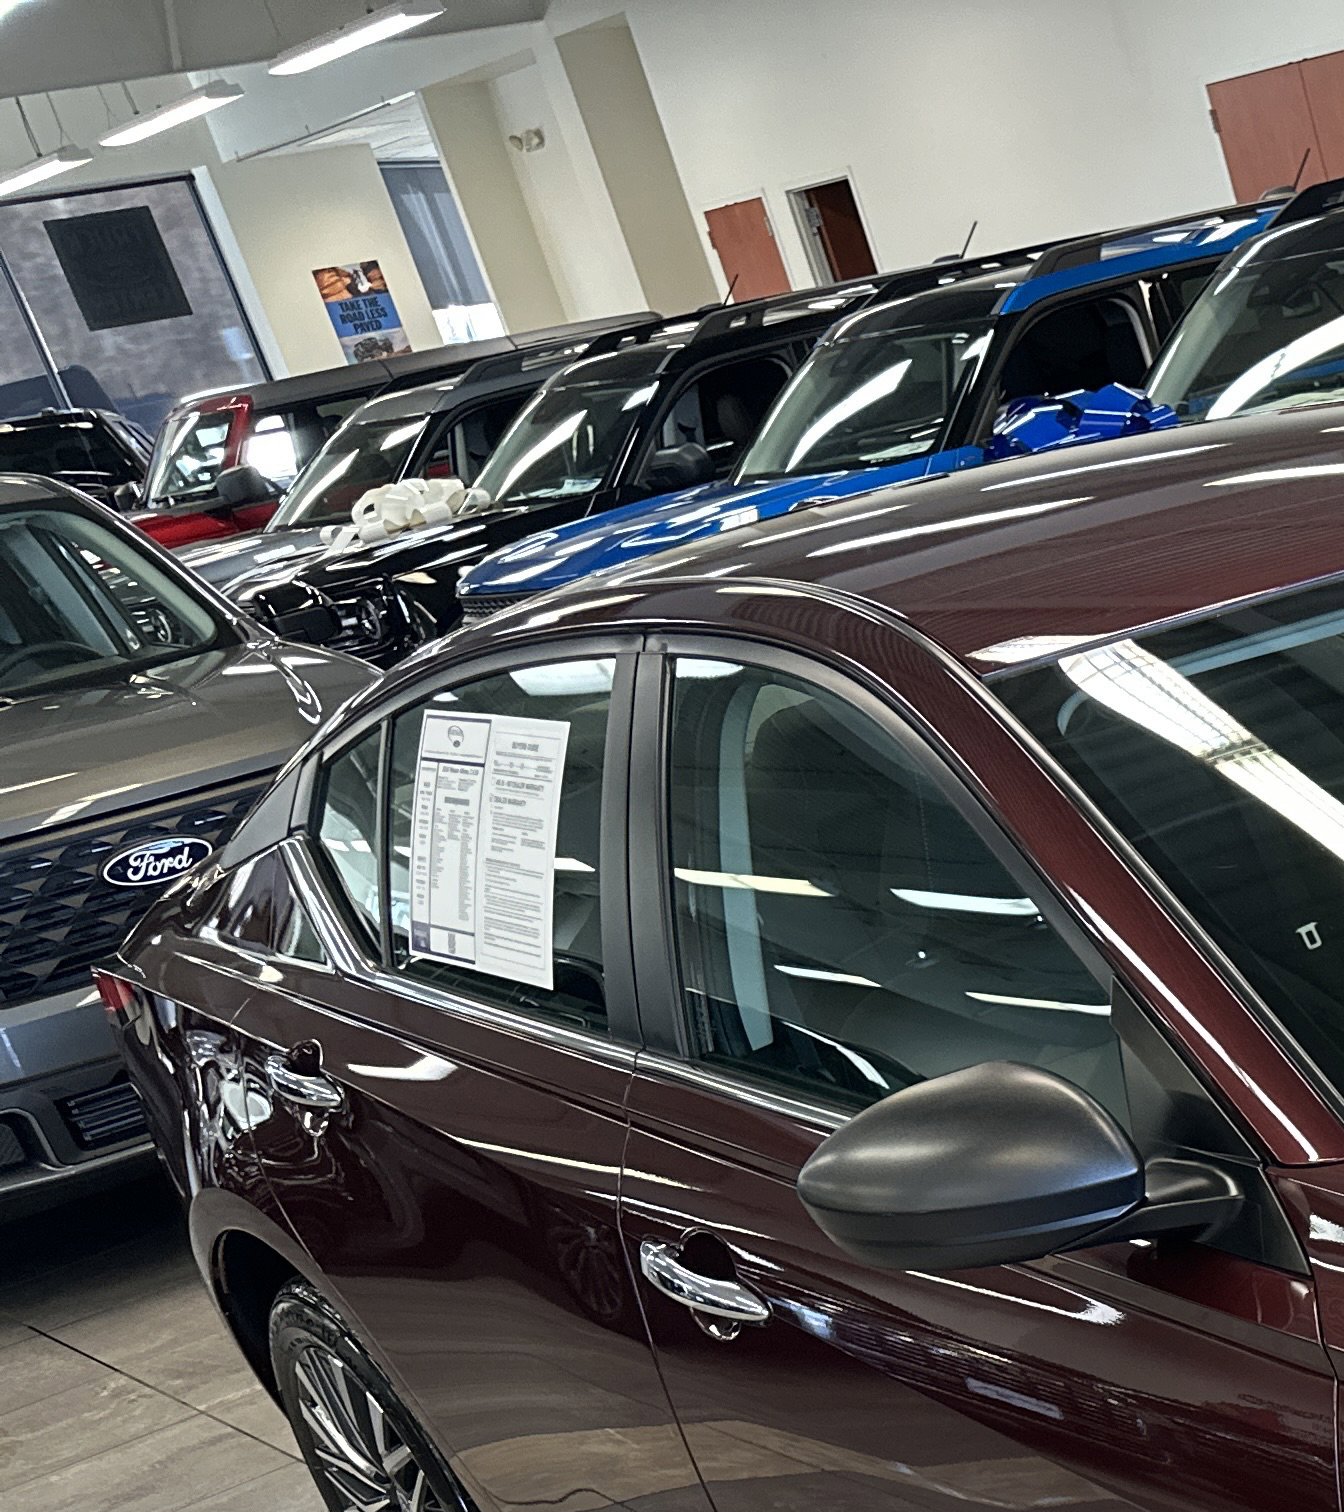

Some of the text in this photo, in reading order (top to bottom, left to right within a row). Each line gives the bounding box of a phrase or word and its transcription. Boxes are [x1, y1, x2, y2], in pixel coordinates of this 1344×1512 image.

[339, 297, 380, 313] TAKE THE
[340, 308, 388, 325] ROAD LESS
[353, 320, 382, 335] PAVED
[127, 846, 193, 881] Ford
